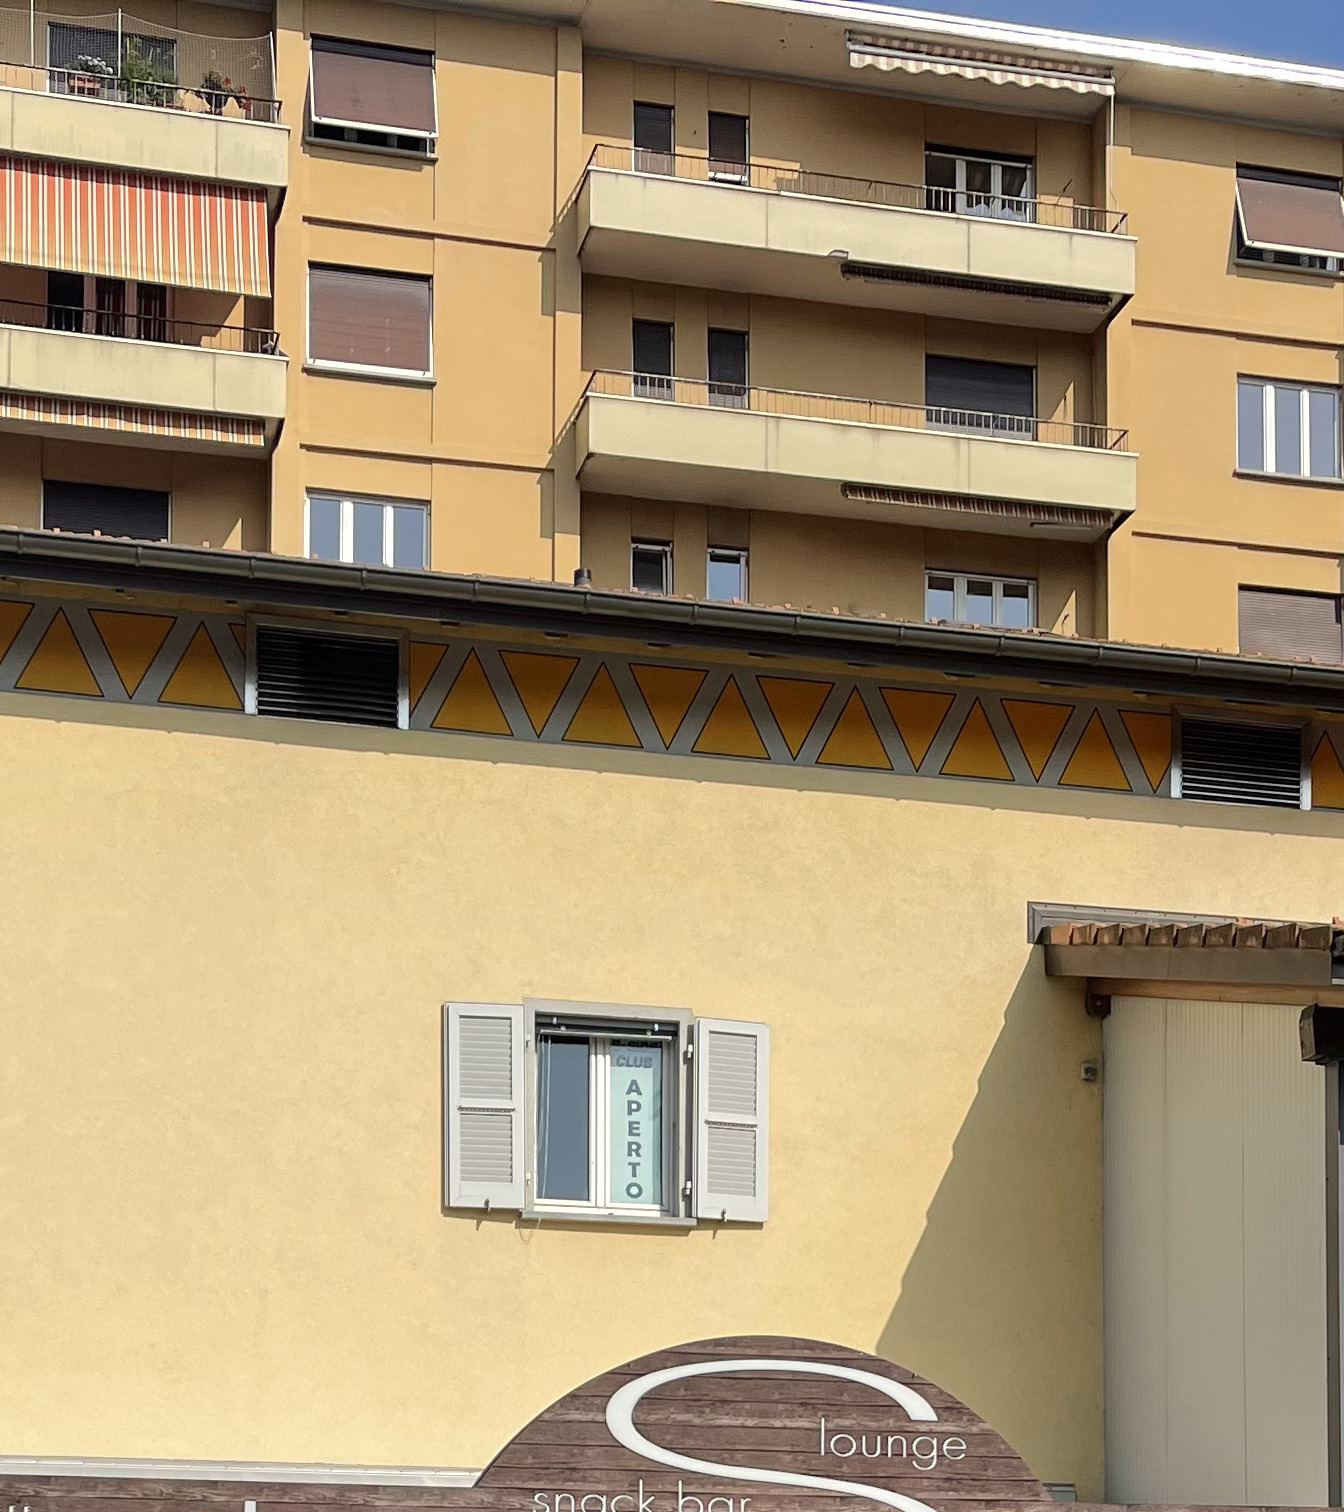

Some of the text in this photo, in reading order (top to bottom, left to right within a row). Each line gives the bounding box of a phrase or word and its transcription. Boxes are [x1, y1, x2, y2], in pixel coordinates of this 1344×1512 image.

[616, 1054, 653, 1069] CLUB
[625, 1079, 644, 1199] APERTO
[819, 1418, 968, 1470] lounge
